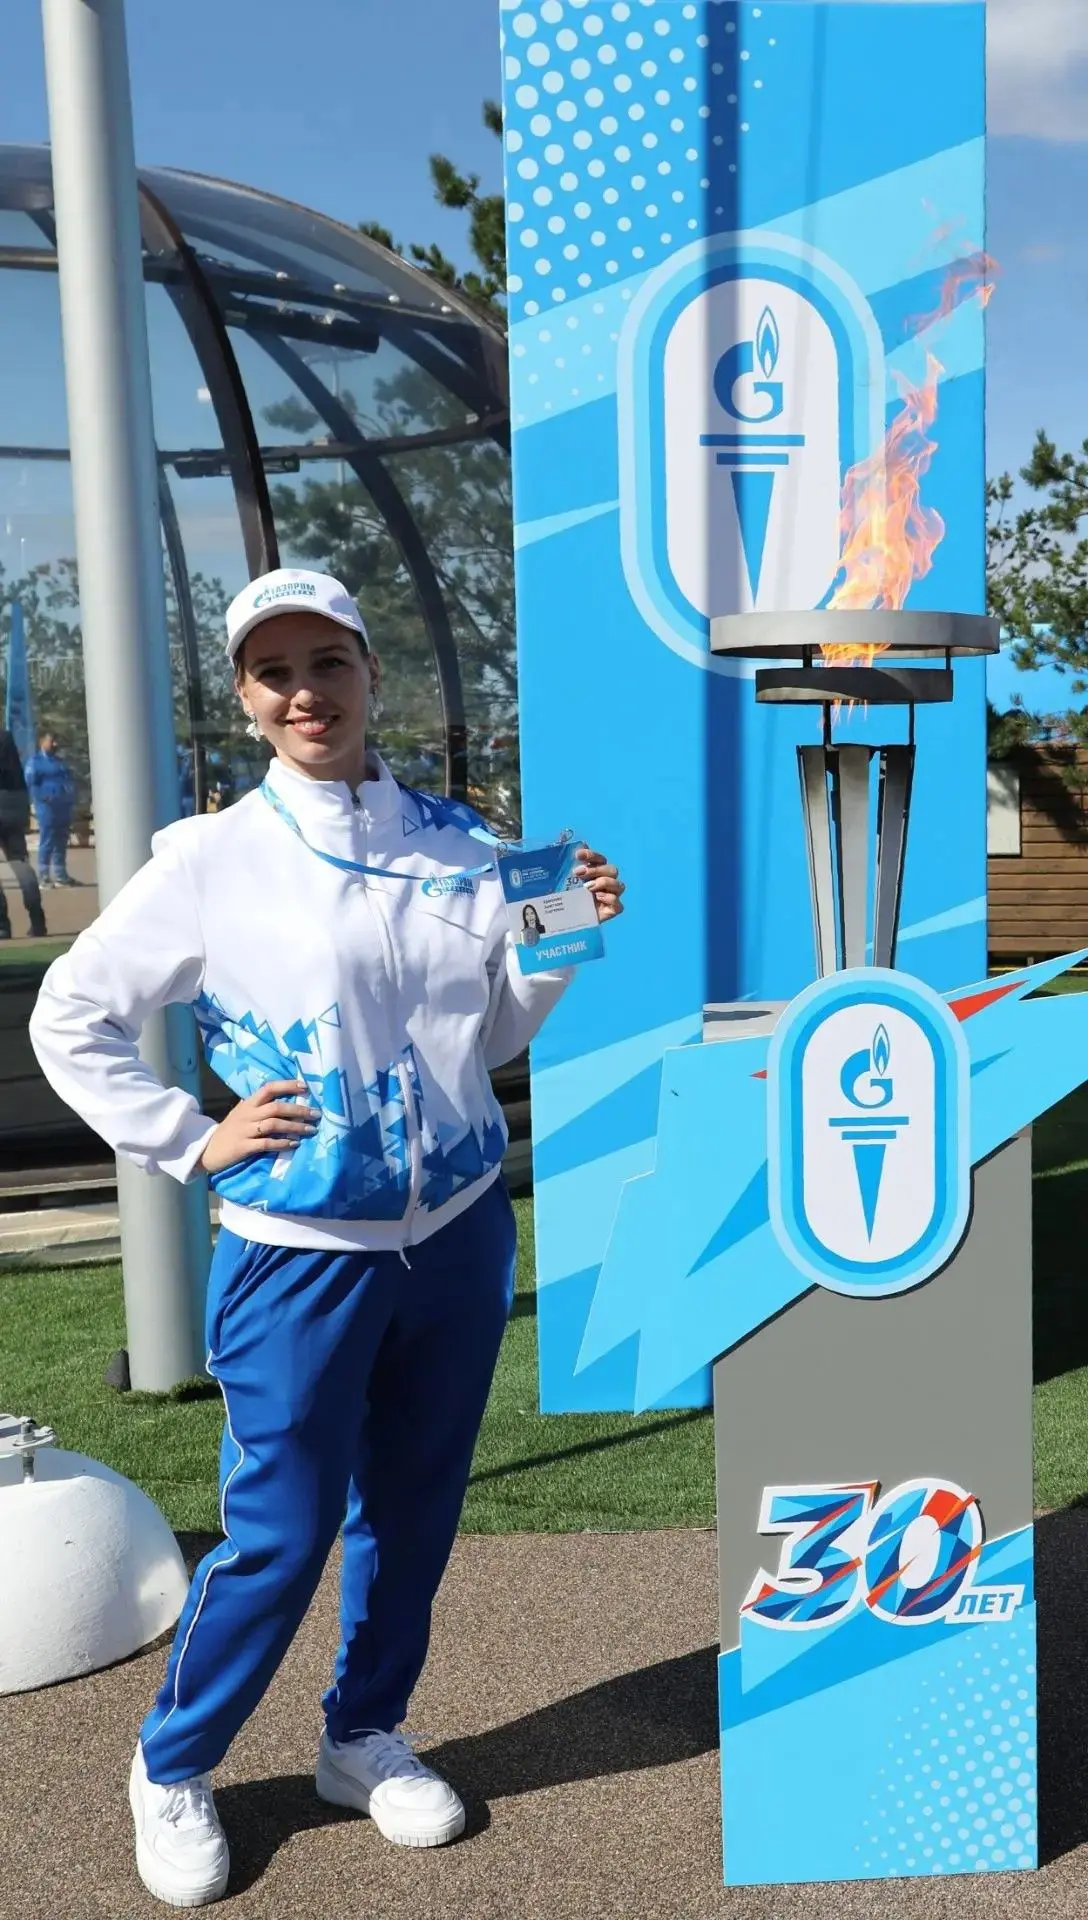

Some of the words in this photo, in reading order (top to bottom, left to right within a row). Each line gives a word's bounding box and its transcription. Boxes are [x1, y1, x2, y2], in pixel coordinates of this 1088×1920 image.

[535, 940, 588, 961] УЧАСТНИК
[742, 1479, 985, 1631] 30
[954, 1592, 1015, 1616] ЛЕТ
